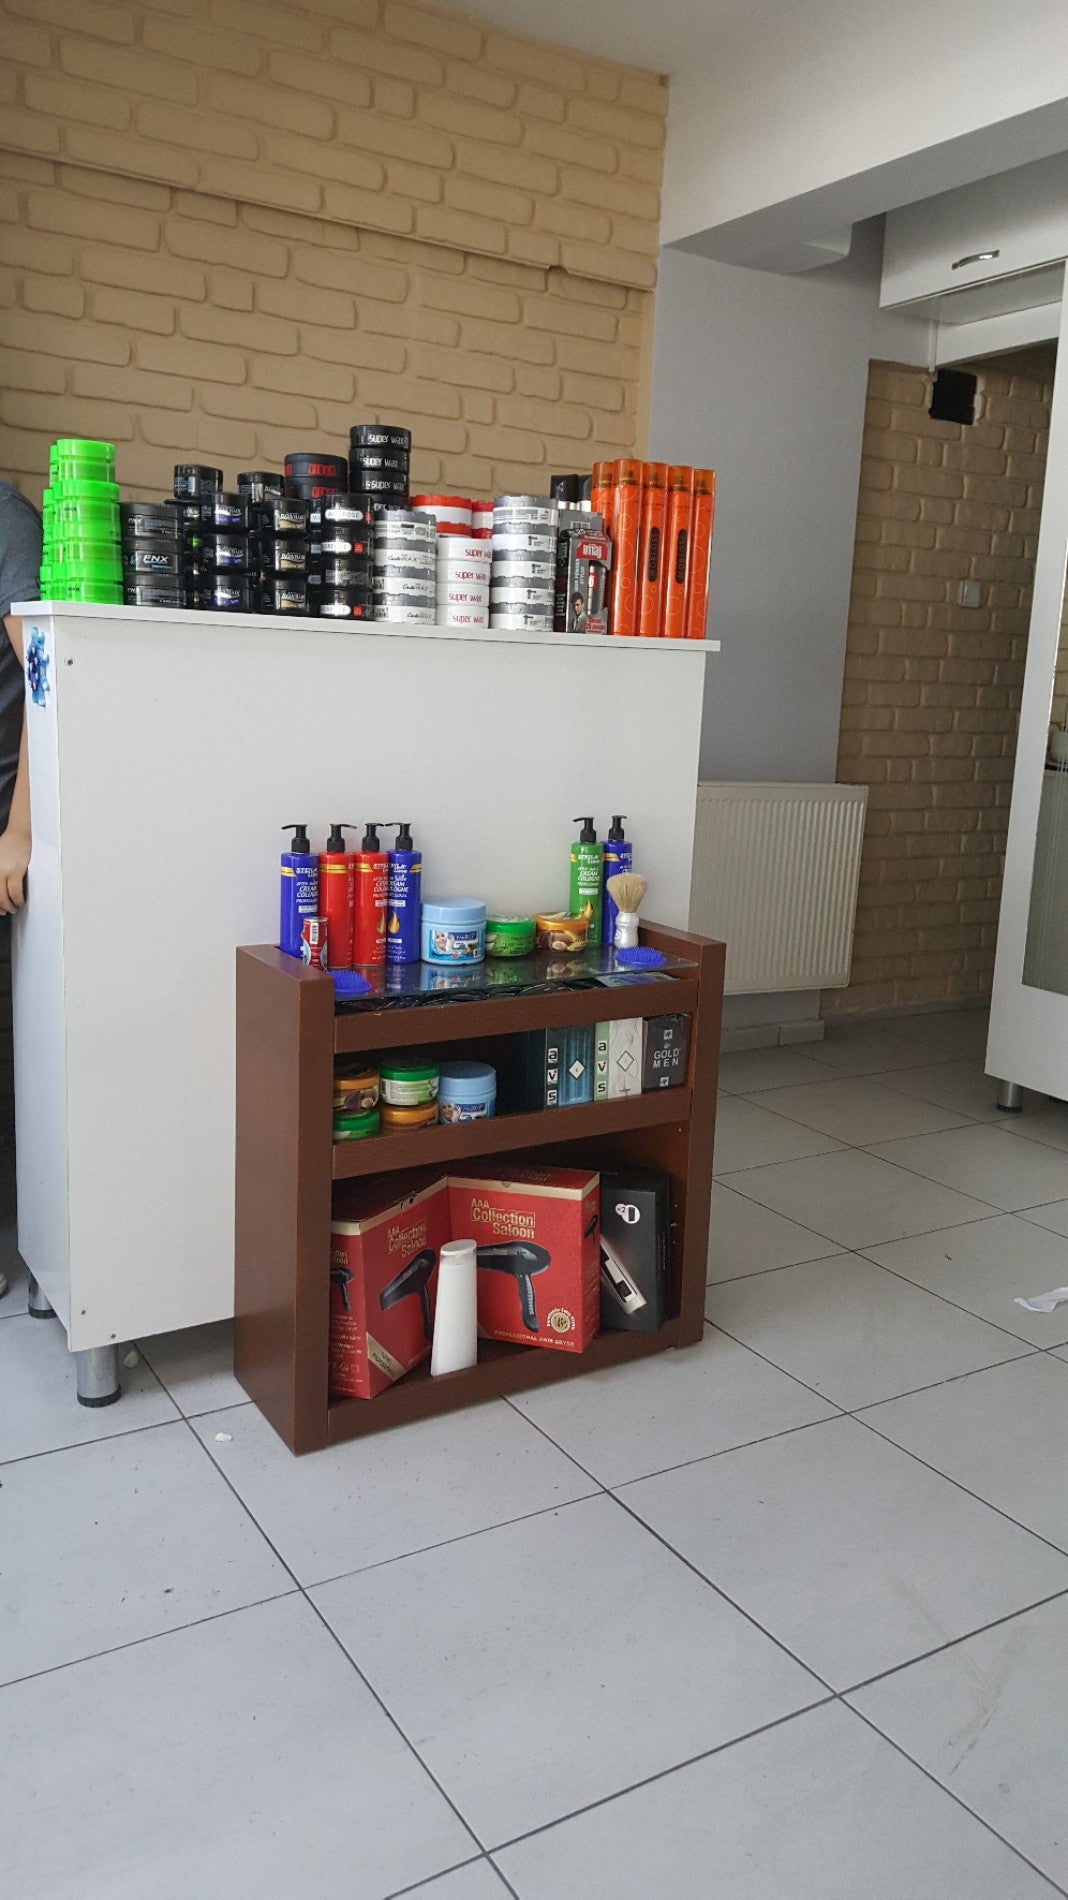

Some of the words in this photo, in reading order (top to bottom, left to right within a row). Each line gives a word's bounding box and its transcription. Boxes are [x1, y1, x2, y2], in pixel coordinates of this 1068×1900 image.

[465, 549, 482, 558] super
[455, 571, 474, 580] super
[476, 572, 486, 580] wax
[449, 593, 467, 602] super
[470, 594, 482, 602] wax
[452, 615, 471, 624] super
[653, 1049, 680, 1059] GOLD
[653, 1058, 679, 1068] MEN
[471, 1198, 489, 1208] AAA
[472, 1208, 534, 1226] Collection
[493, 1222, 534, 1239] Saloon
